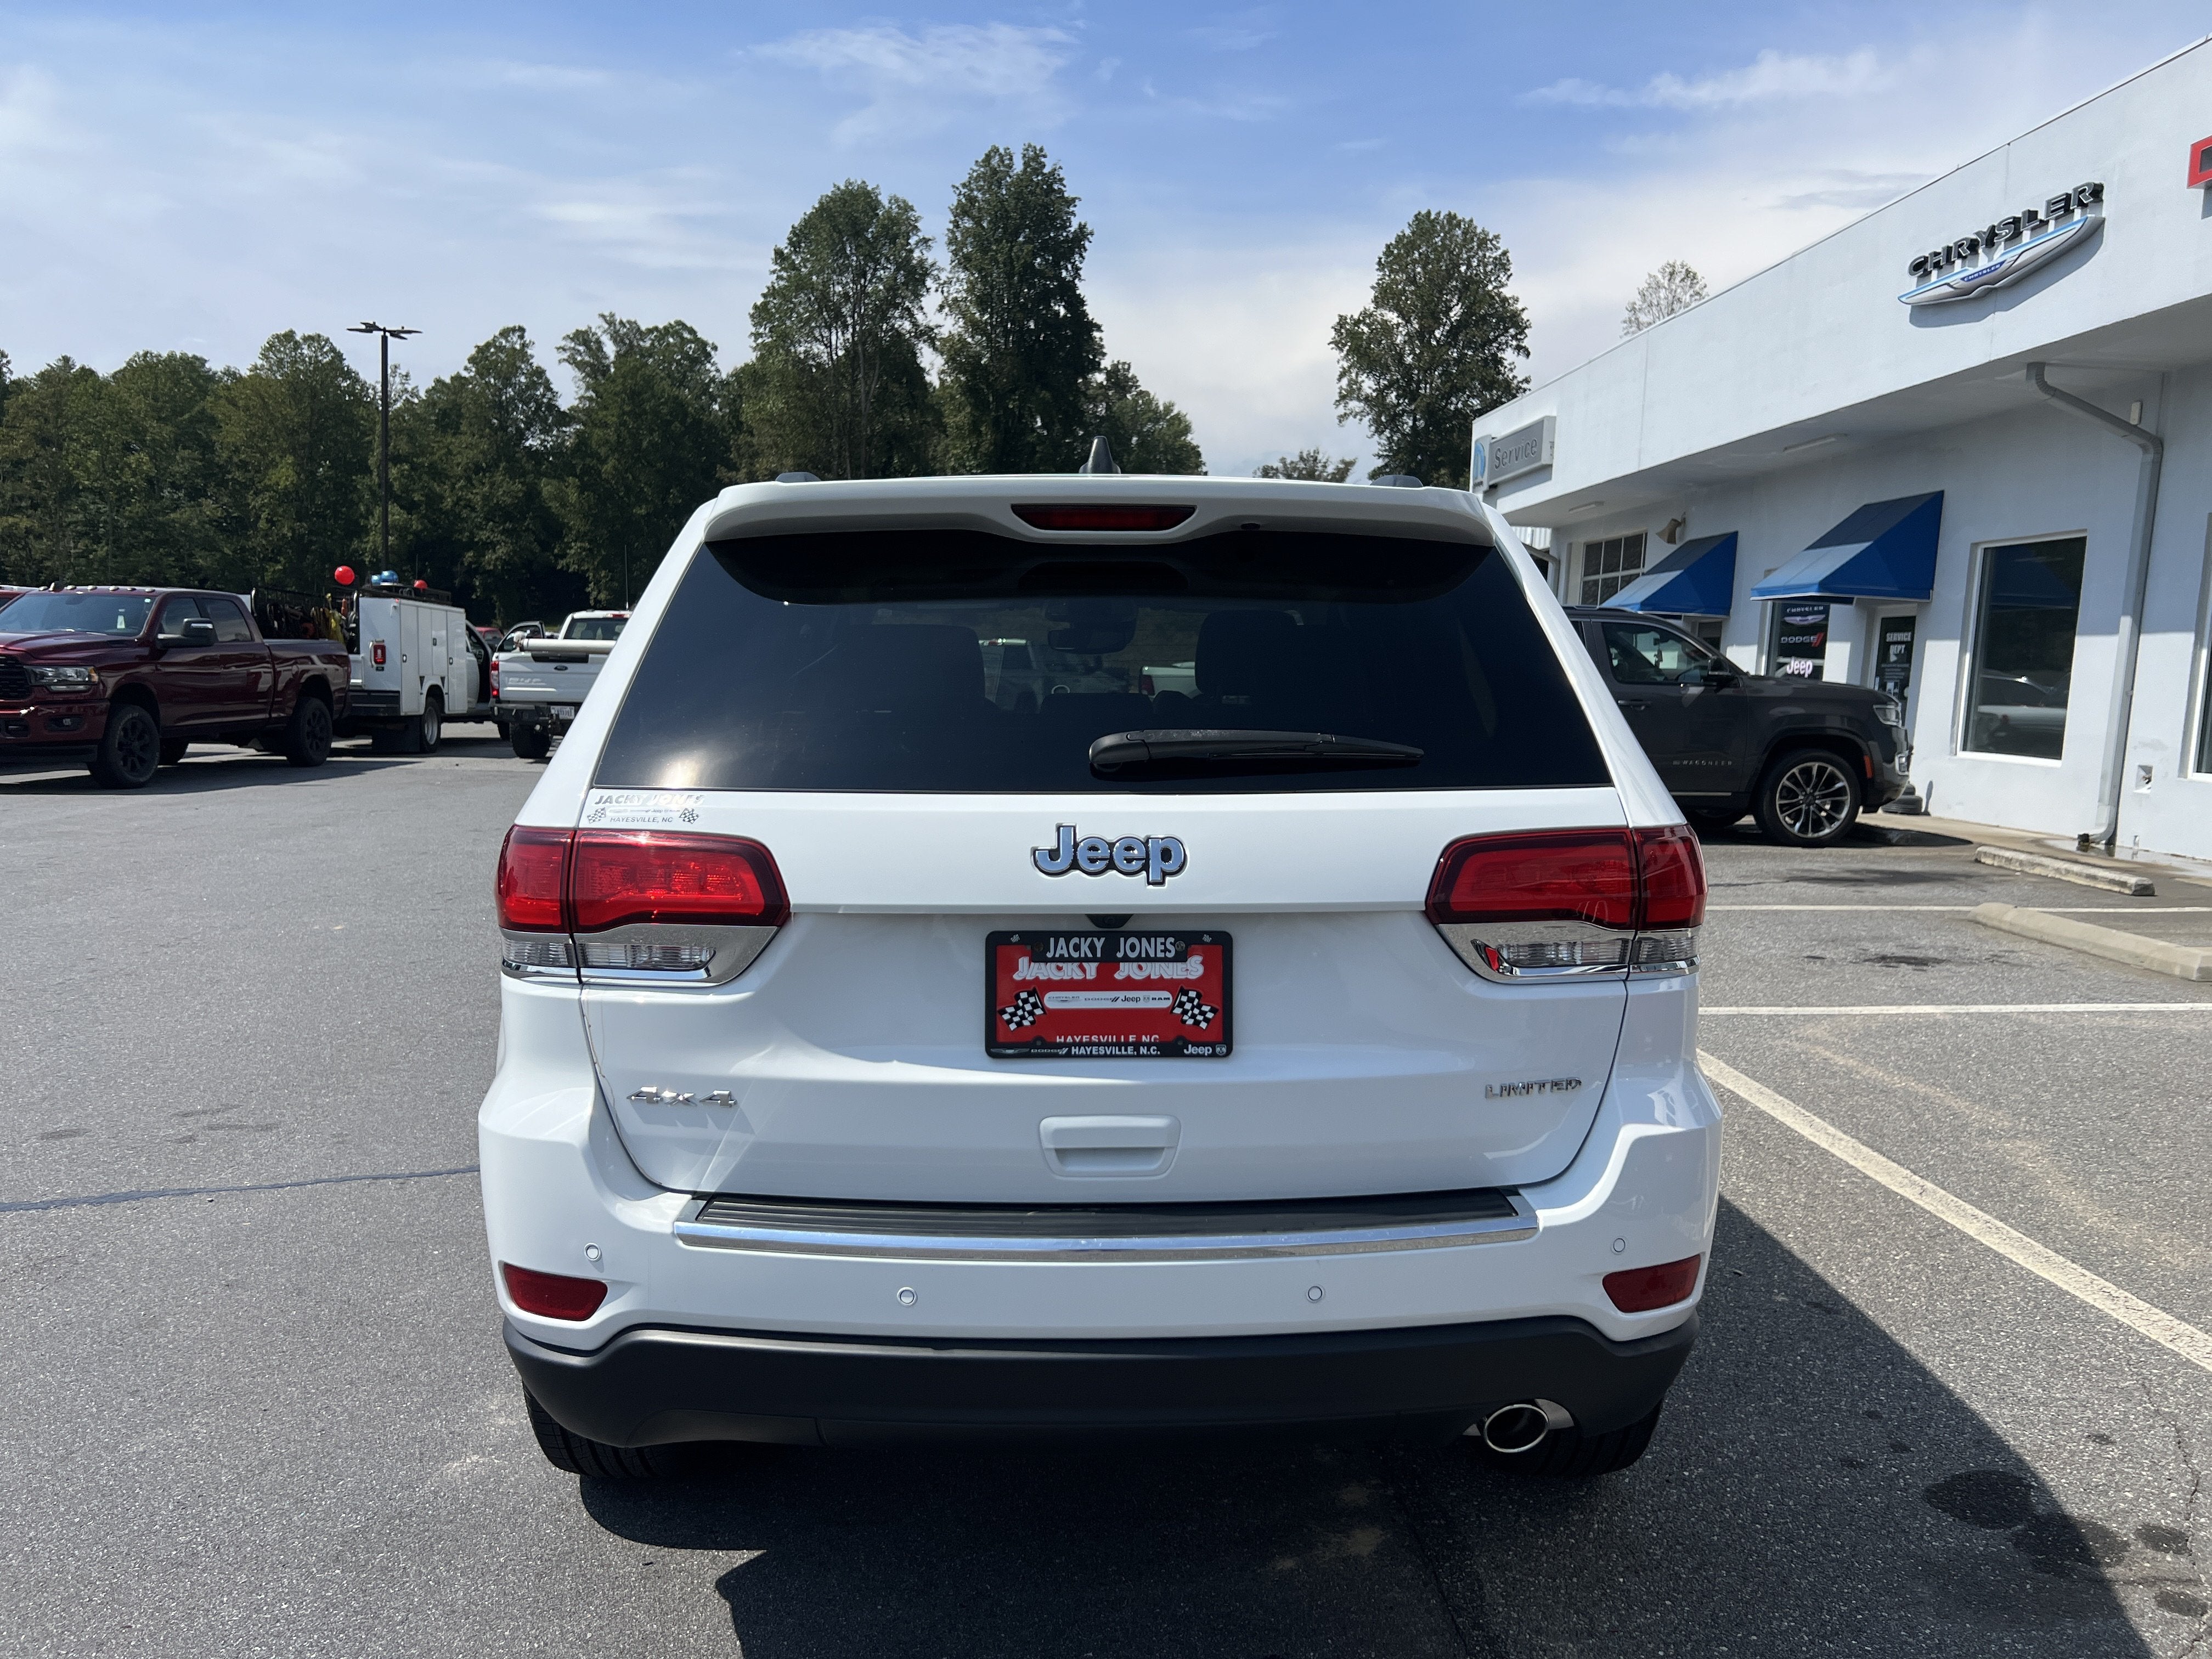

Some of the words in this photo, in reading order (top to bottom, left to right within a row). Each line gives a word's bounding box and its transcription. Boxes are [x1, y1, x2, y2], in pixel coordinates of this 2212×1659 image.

[1908, 182, 2104, 276] CHRYSLER
[1494, 438, 1537, 470] Service
[1781, 635, 1818, 644] DODGE
[1886, 631, 1912, 642] SERVICE
[1786, 656, 1813, 678] Jeep
[594, 794, 647, 805] JACKY
[648, 794, 705, 805] JONES
[1033, 824, 1188, 887] Jeep
[1046, 937, 1105, 958] JACKY
[1116, 937, 1176, 958] JONES
[1013, 956, 1099, 980] JACKY
[1114, 955, 1204, 980] JONES
[1071, 1046, 1137, 1056] HAYESVILLE,
[1139, 1046, 1161, 1055] N.C.
[1183, 1044, 1212, 1056] Jeep
[1485, 1076, 1582, 1098] LIMITED
